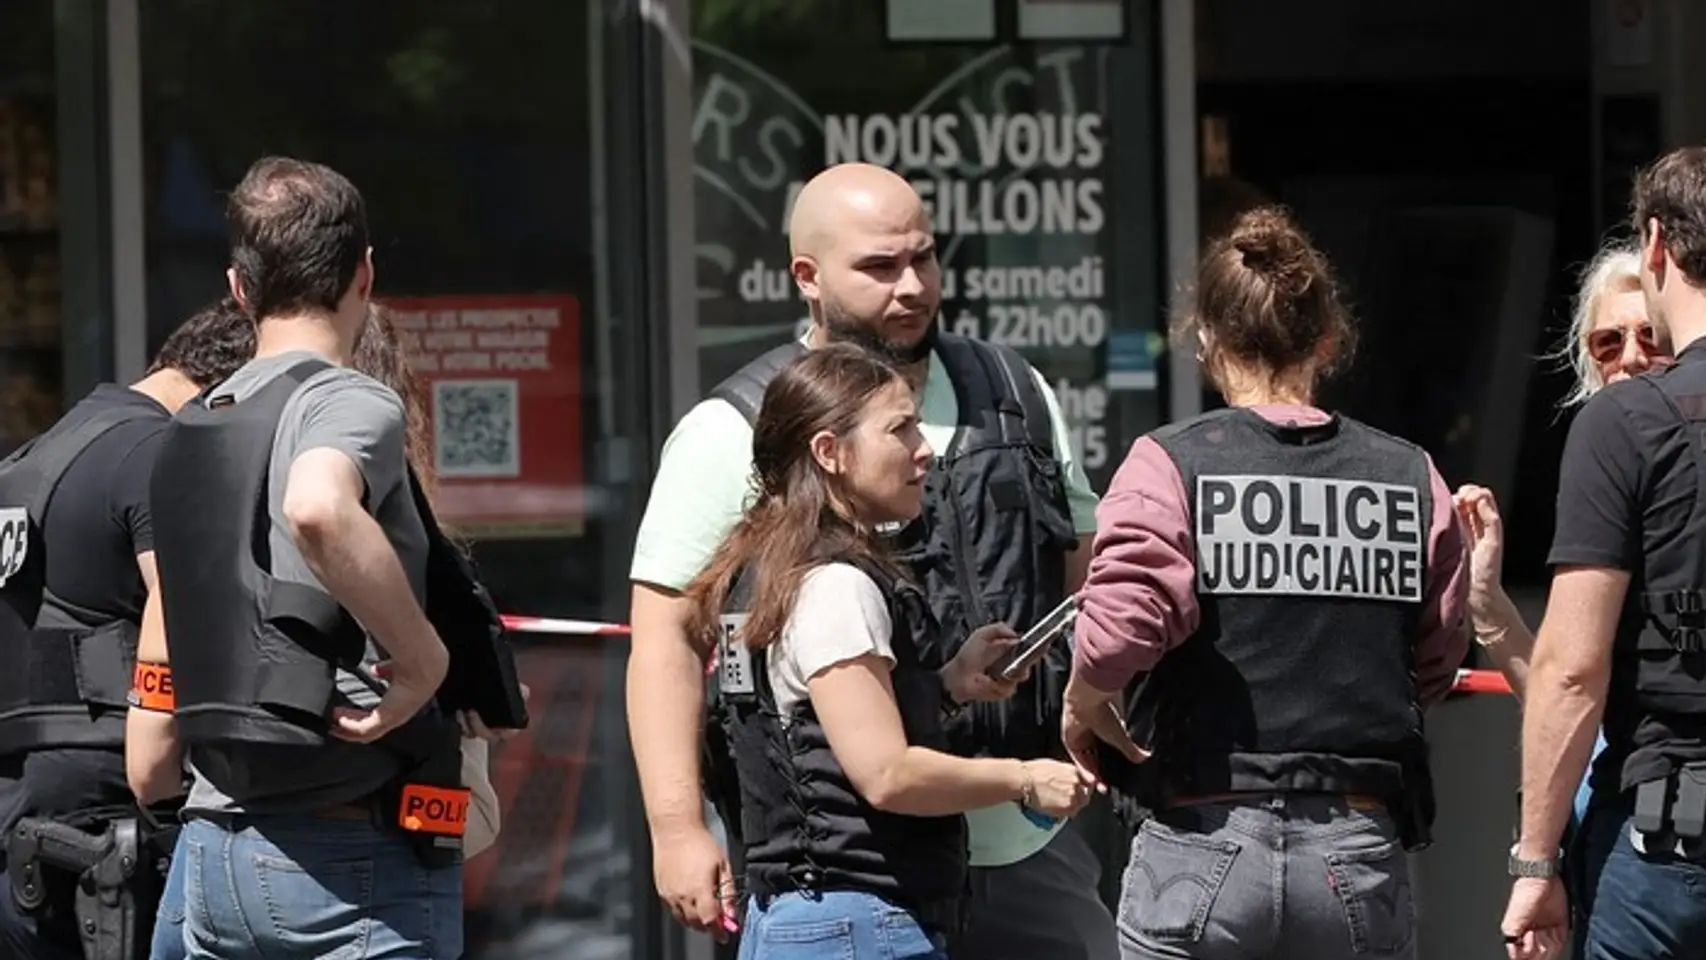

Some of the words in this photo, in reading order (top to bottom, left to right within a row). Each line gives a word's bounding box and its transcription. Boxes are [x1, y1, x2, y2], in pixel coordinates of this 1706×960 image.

[824, 113, 959, 168] NOUS
[977, 113, 1103, 168] VOUS
[738, 260, 789, 301] du
[964, 256, 1104, 298] samedi
[986, 304, 1104, 346] 22h00
[1201, 480, 1418, 544] POLICE
[1202, 542, 1418, 597] JUDICIAIRE
